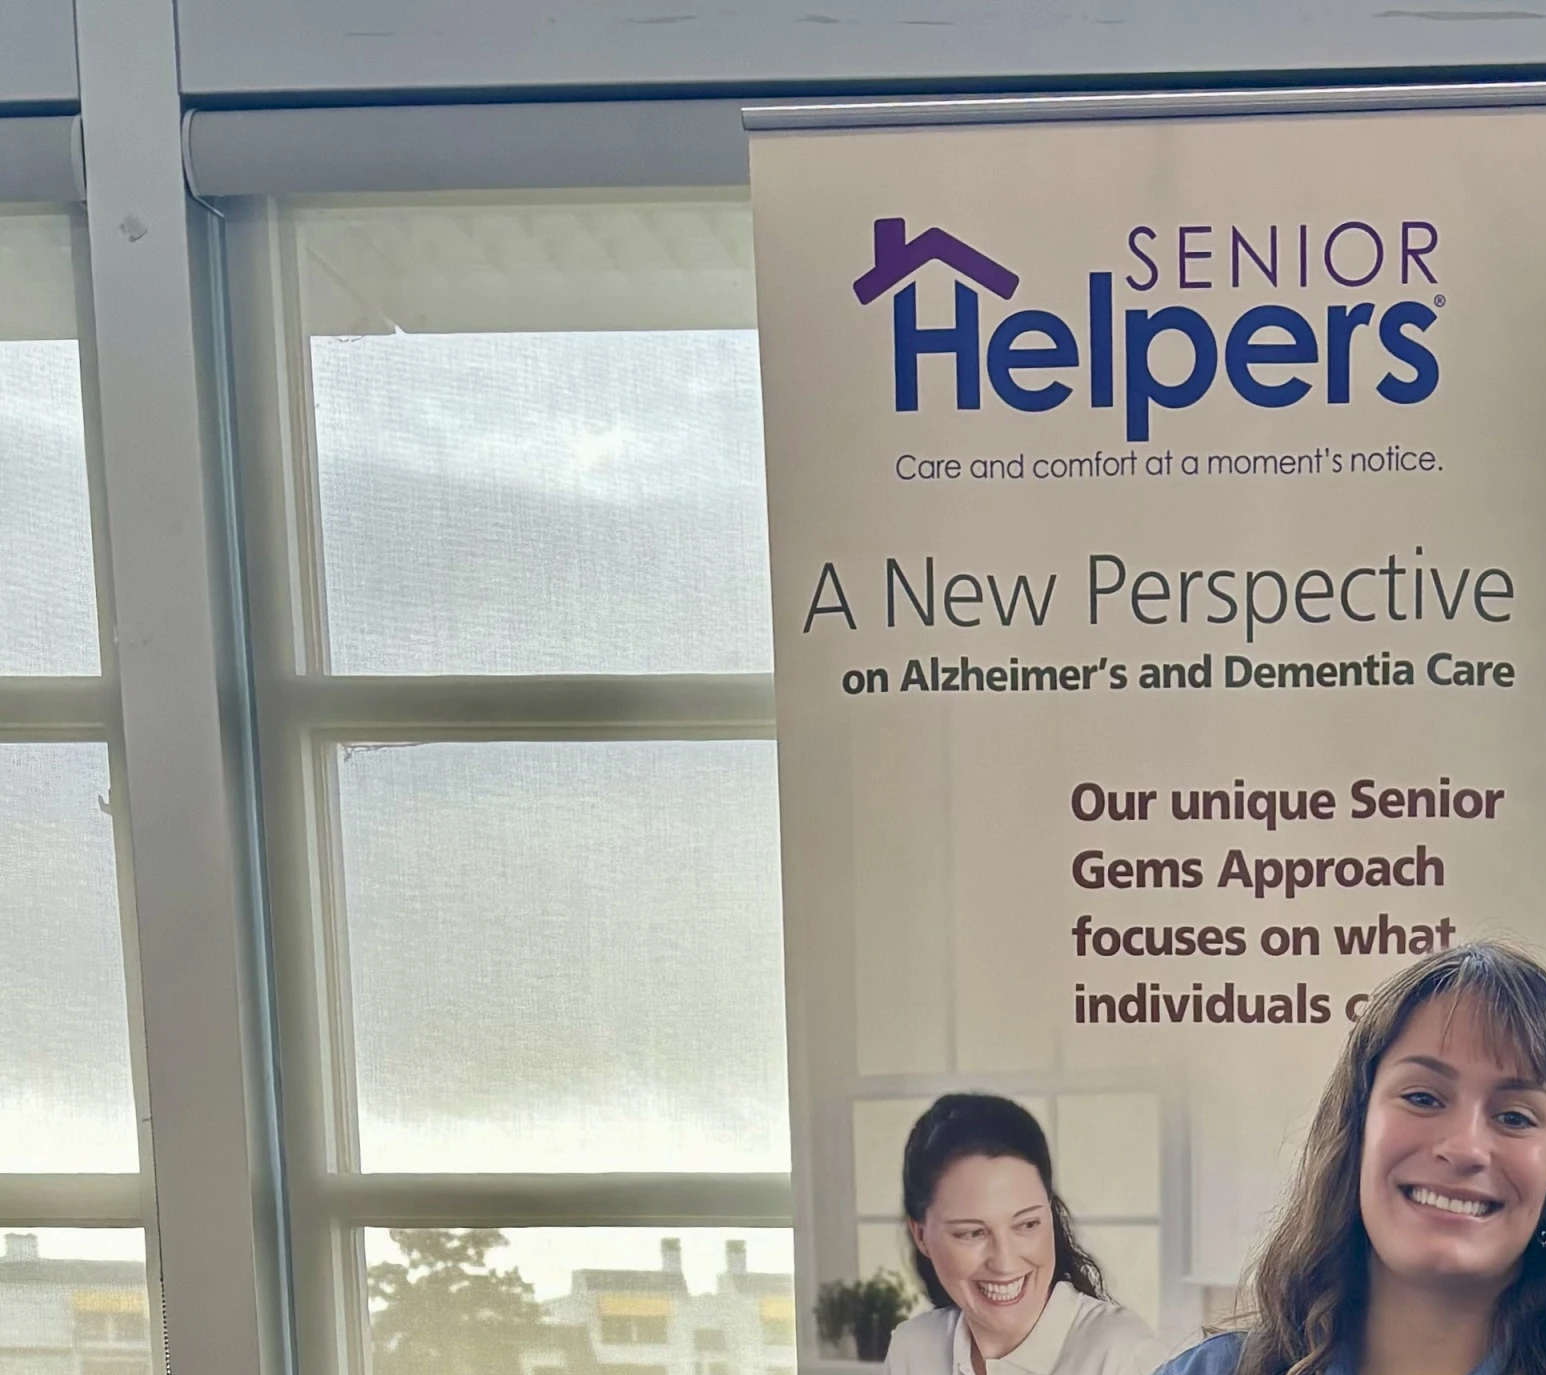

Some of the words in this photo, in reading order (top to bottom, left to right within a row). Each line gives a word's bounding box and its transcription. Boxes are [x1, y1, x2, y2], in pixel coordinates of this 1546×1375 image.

[1126, 220, 1440, 292] SENIOR
[895, 454, 962, 482] Care
[970, 452, 1026, 479] and
[1032, 450, 1138, 478] comfort
[1144, 452, 1174, 476] at
[1181, 457, 1200, 476] a
[1206, 448, 1343, 477] moment's
[1349, 447, 1444, 474] notice.
[802, 562, 857, 636] A
[885, 556, 1057, 628] New
[1088, 546, 1516, 643] Perspective
[841, 669, 889, 695] on
[900, 657, 1128, 693] Alzheimer's
[1139, 656, 1214, 690] and
[1224, 652, 1415, 690] Dementia
[1427, 652, 1516, 689] Care
[1071, 781, 1158, 823] Our
[1171, 779, 1337, 831] unique
[1349, 777, 1505, 821] Senior
[1072, 848, 1204, 890] Gems
[1216, 844, 1445, 899] Approach
[1073, 915, 1246, 958] focuses
[1261, 924, 1320, 957] on
[1334, 914, 1456, 955] what
[1073, 982, 1332, 1025] individuals
